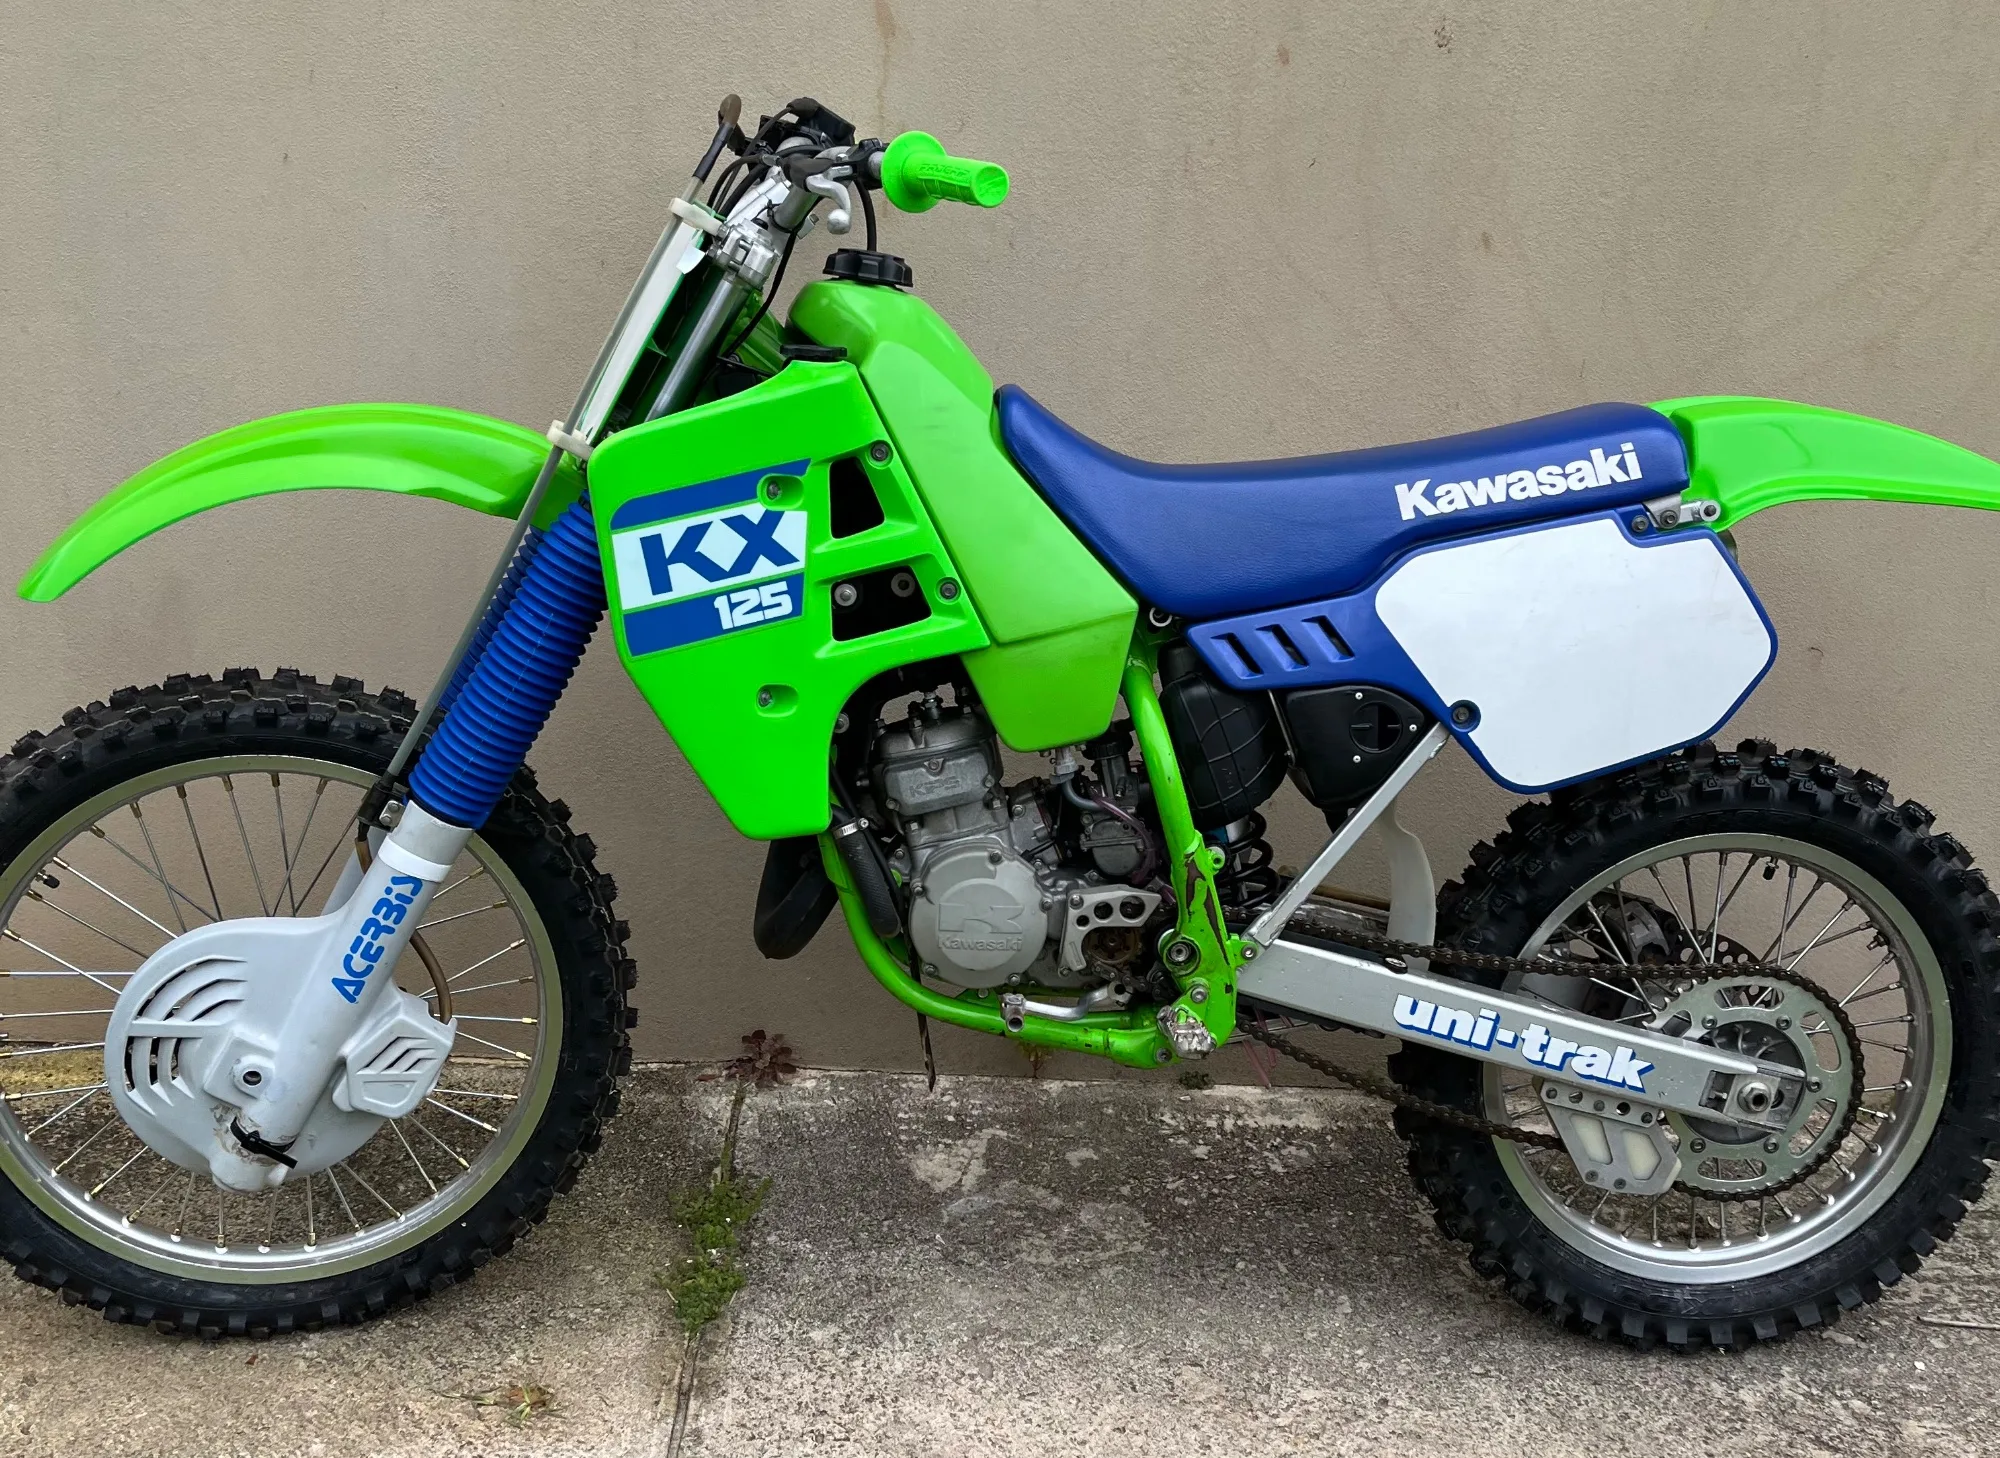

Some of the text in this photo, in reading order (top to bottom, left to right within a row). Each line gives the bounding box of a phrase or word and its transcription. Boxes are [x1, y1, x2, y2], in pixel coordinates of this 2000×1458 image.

[1395, 442, 1643, 521] Kawasaki
[639, 509, 800, 596] KX
[713, 581, 793, 630] 125
[938, 936, 1022, 952] Kawasaki
[1393, 994, 1655, 1093] uni-trak
